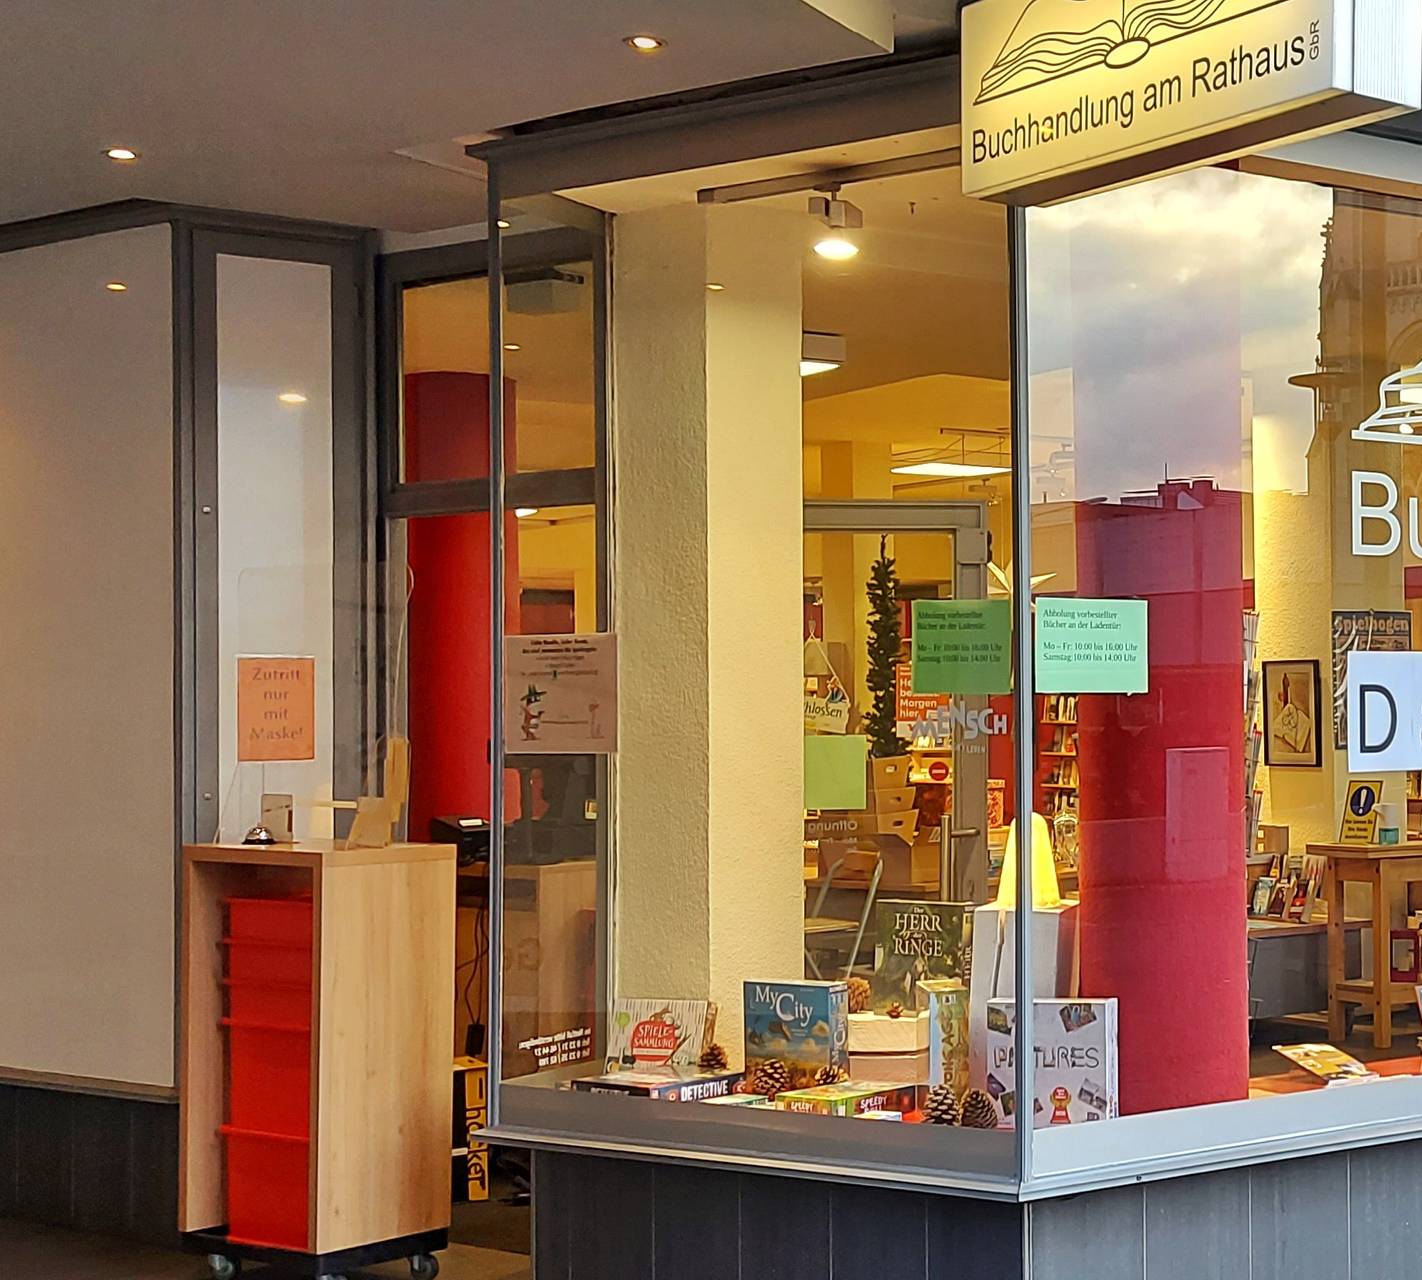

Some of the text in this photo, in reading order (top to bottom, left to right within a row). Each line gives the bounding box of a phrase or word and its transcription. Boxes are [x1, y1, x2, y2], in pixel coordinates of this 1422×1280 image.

[1308, 19, 1320, 61] GbR
[971, 34, 1305, 164] Buchhandlung am Rathaus
[252, 667, 300, 681] Zutritt
[264, 690, 289, 700] nur
[900, 699, 937, 710] Morgen
[264, 707, 288, 719] mit
[804, 701, 843, 718] hlossen
[911, 700, 1008, 741] MENSCH
[894, 912, 943, 934] HERR
[893, 937, 944, 957] RINGE
[755, 985, 813, 1027] My City
[639, 1023, 674, 1038] SPIELE-
[681, 1080, 729, 1101] DETECTIVE
[465, 1107, 488, 1191] hoker
